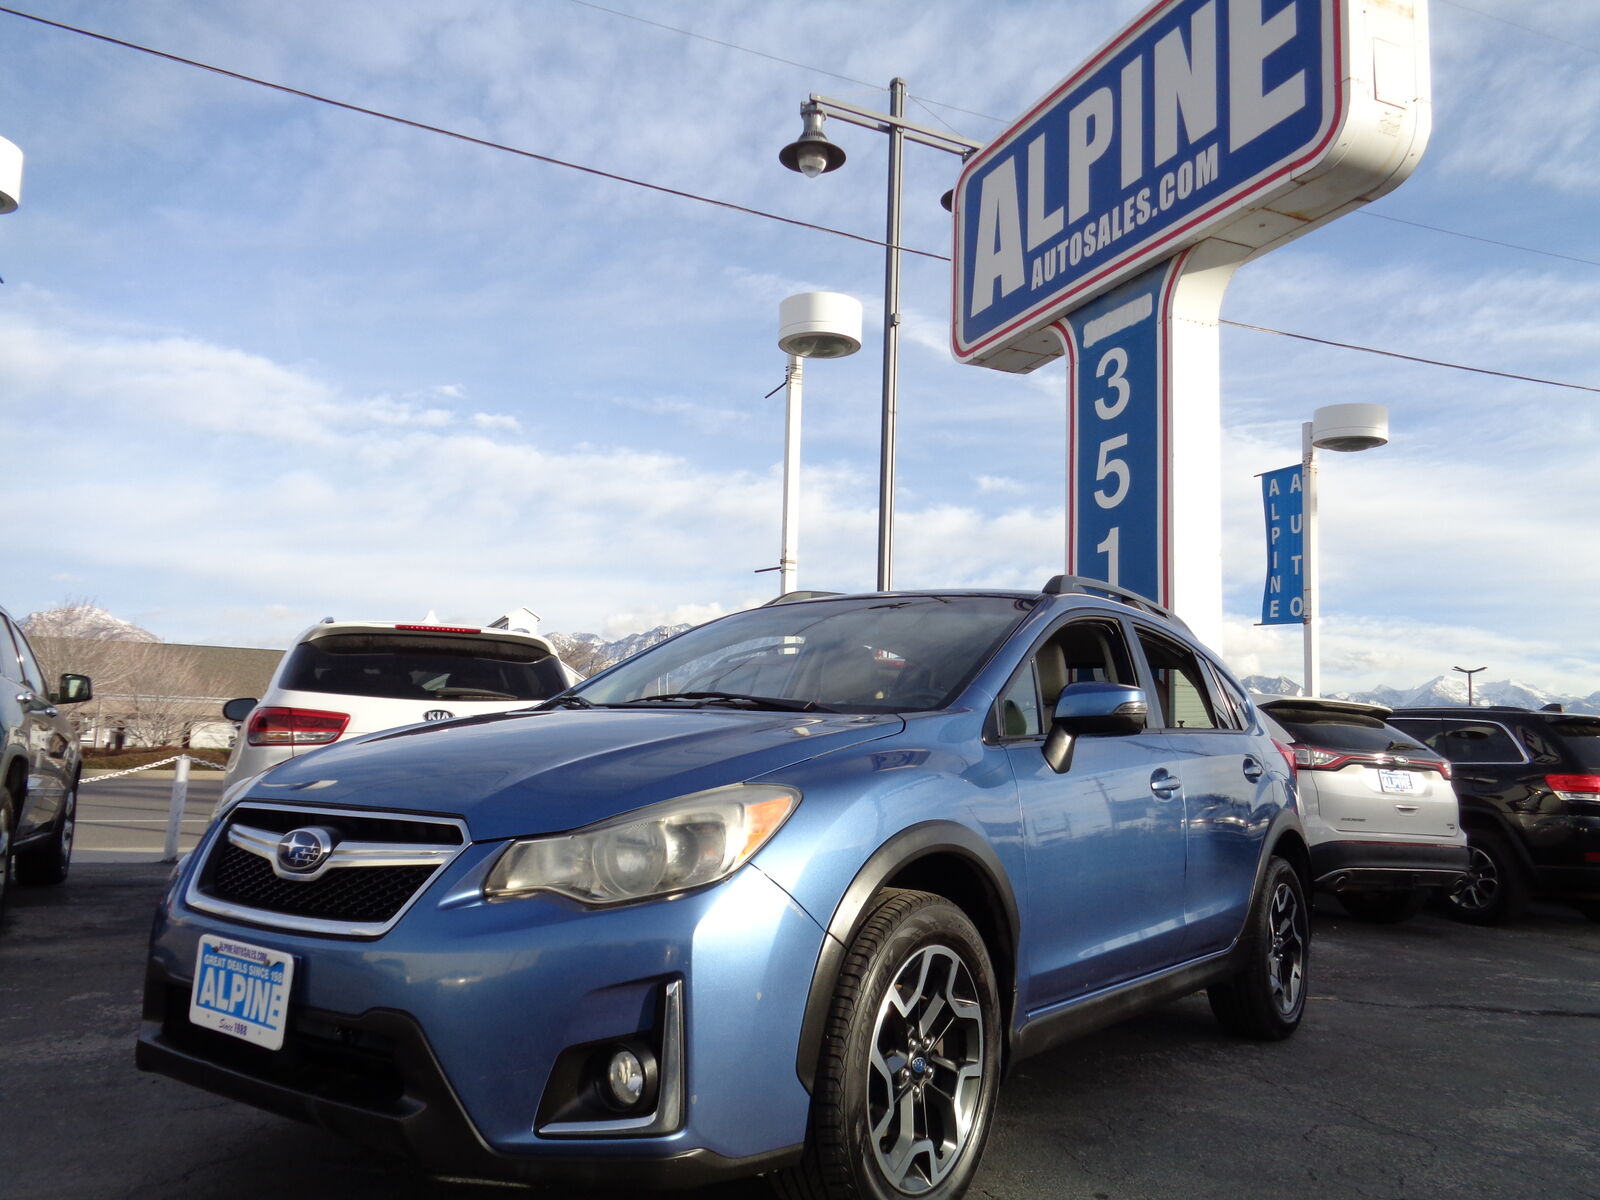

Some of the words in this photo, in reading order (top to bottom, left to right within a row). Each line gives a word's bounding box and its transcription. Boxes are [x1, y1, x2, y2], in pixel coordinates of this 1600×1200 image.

[971, 0, 1306, 319] ALPINE
[1030, 142, 1219, 292] AUTOSALES.COM
[1268, 478, 1281, 618] ALPINE
[1289, 473, 1303, 617] AUTO
[427, 710, 450, 721] KIA
[199, 966, 282, 1026] ALPINE
[203, 954, 226, 969] GREAT
[227, 958, 249, 974] DEALS
[249, 965, 270, 980] SINCE
